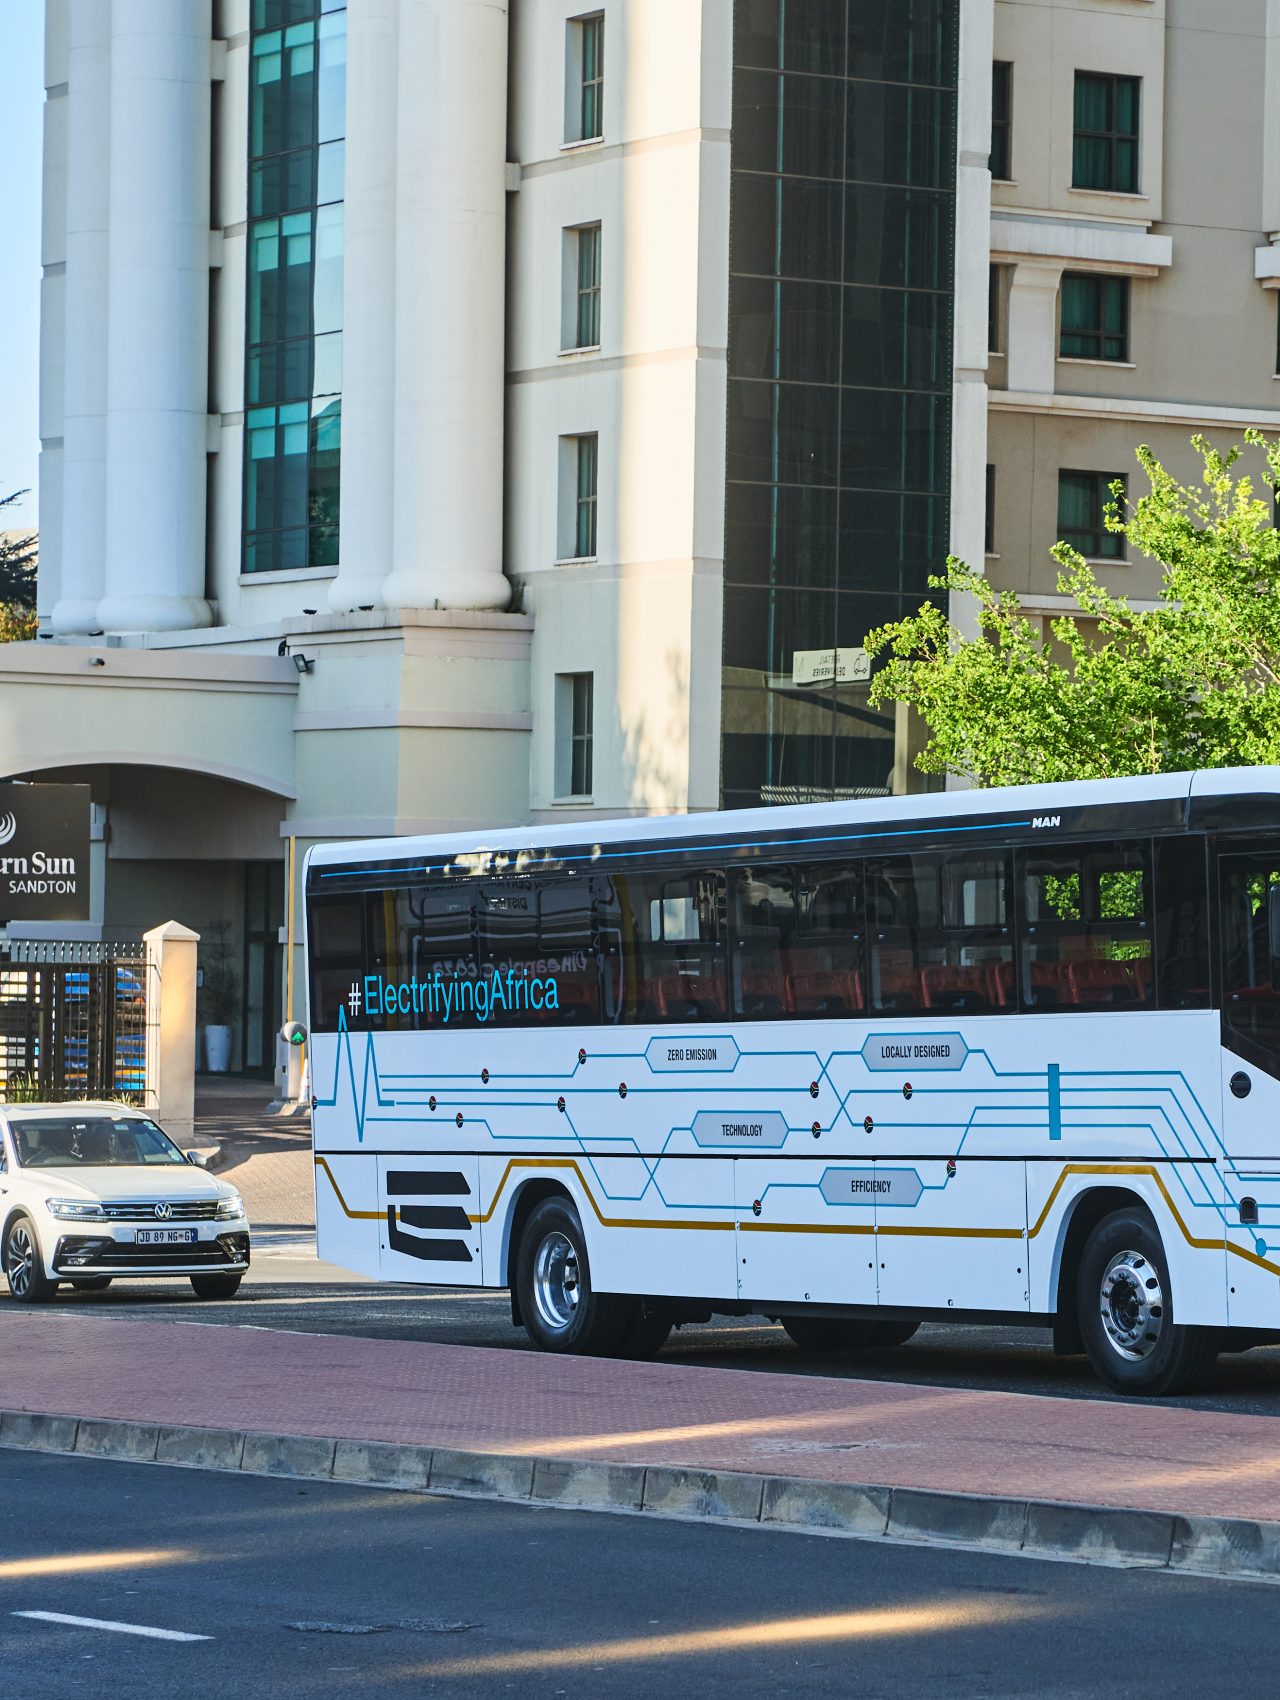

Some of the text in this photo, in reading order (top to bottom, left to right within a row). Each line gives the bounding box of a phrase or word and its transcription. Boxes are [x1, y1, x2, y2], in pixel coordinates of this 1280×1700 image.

[1032, 815, 1061, 828] MAN
[0, 851, 76, 874] rn Sun
[9, 880, 76, 893] SANDTON
[348, 969, 560, 1022] #ElectrifyingAfrica
[667, 1048, 717, 1060] ZERO EMISSION
[881, 1045, 951, 1058] LOCALLY DESIGNED
[722, 1124, 763, 1136] TECHNOLOGY
[851, 1180, 891, 1193] EFFICIENCY
[153, 1231, 164, 1242] 89
[167, 1231, 178, 1241] NG
